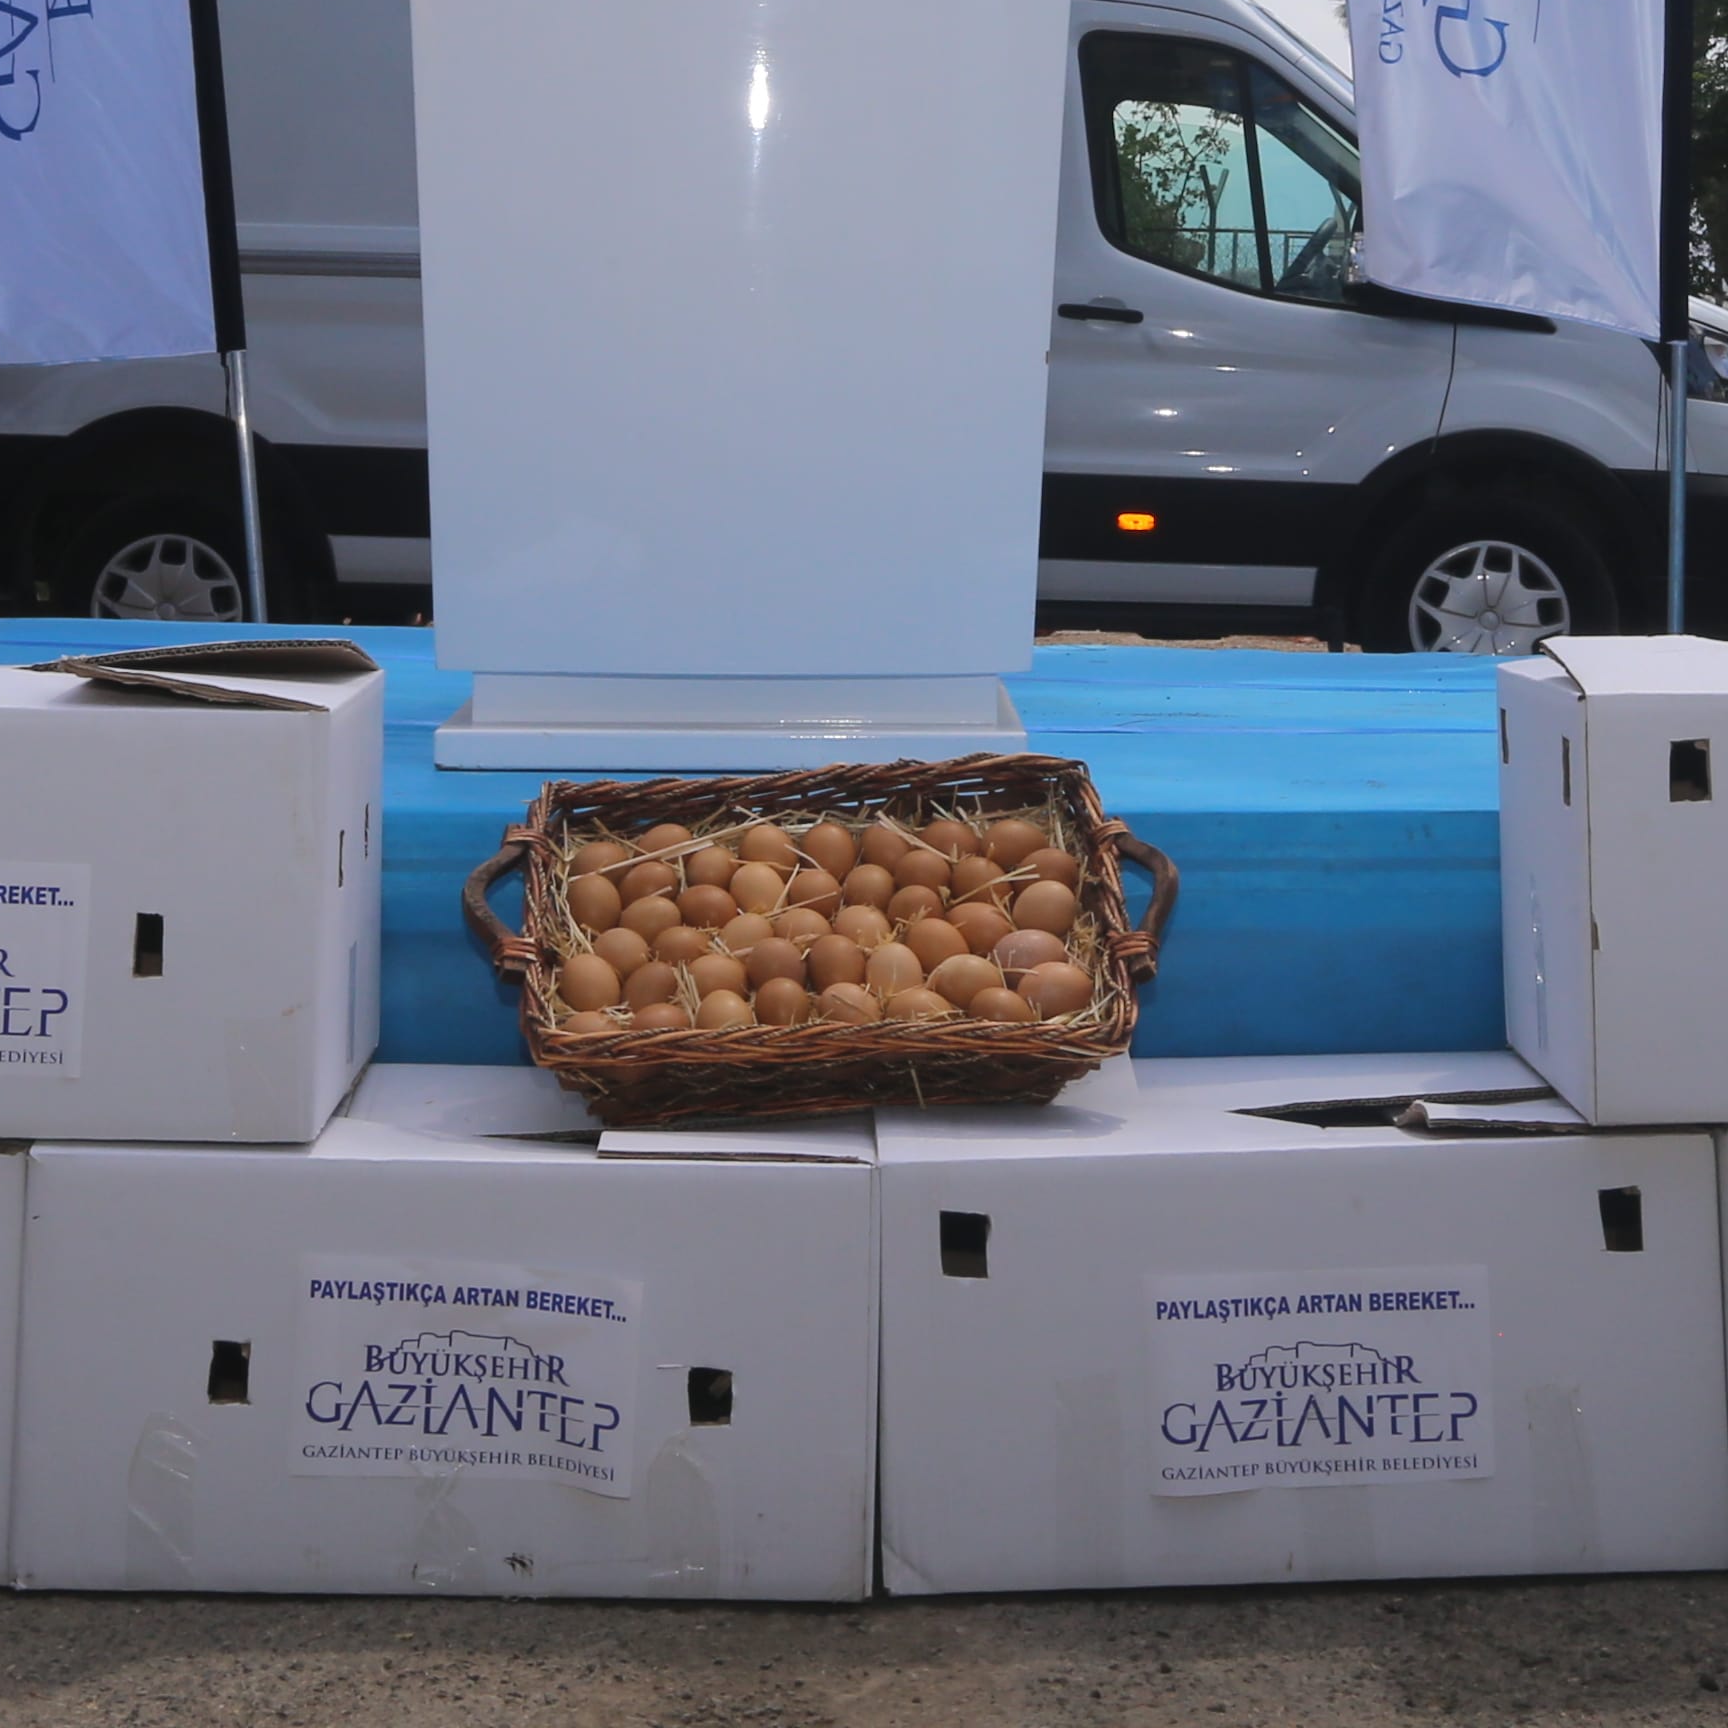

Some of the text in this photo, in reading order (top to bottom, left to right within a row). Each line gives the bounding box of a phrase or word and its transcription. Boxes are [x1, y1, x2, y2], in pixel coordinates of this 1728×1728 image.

[310, 1279, 627, 1323] PAYLAŞTIKÇA ARTAN BEREKET...
[1156, 1290, 1475, 1324] PAYLAŞTIKÇA ARTAN BEREKET...
[364, 1344, 570, 1388] BÜYÜKŞEHİR
[1214, 1355, 1422, 1393] BÜYÜKŞEHİR
[305, 1377, 620, 1453] GAZİANTEP
[1161, 1391, 1478, 1452] GAZİANTEP
[302, 1443, 615, 1483] GAZİANTEP BÜYÜKŞEHİR BELEDİYESİ
[1161, 1452, 1478, 1481] GAZİANTEP BÜYÜKŞEHİR BELEDİYESİ
